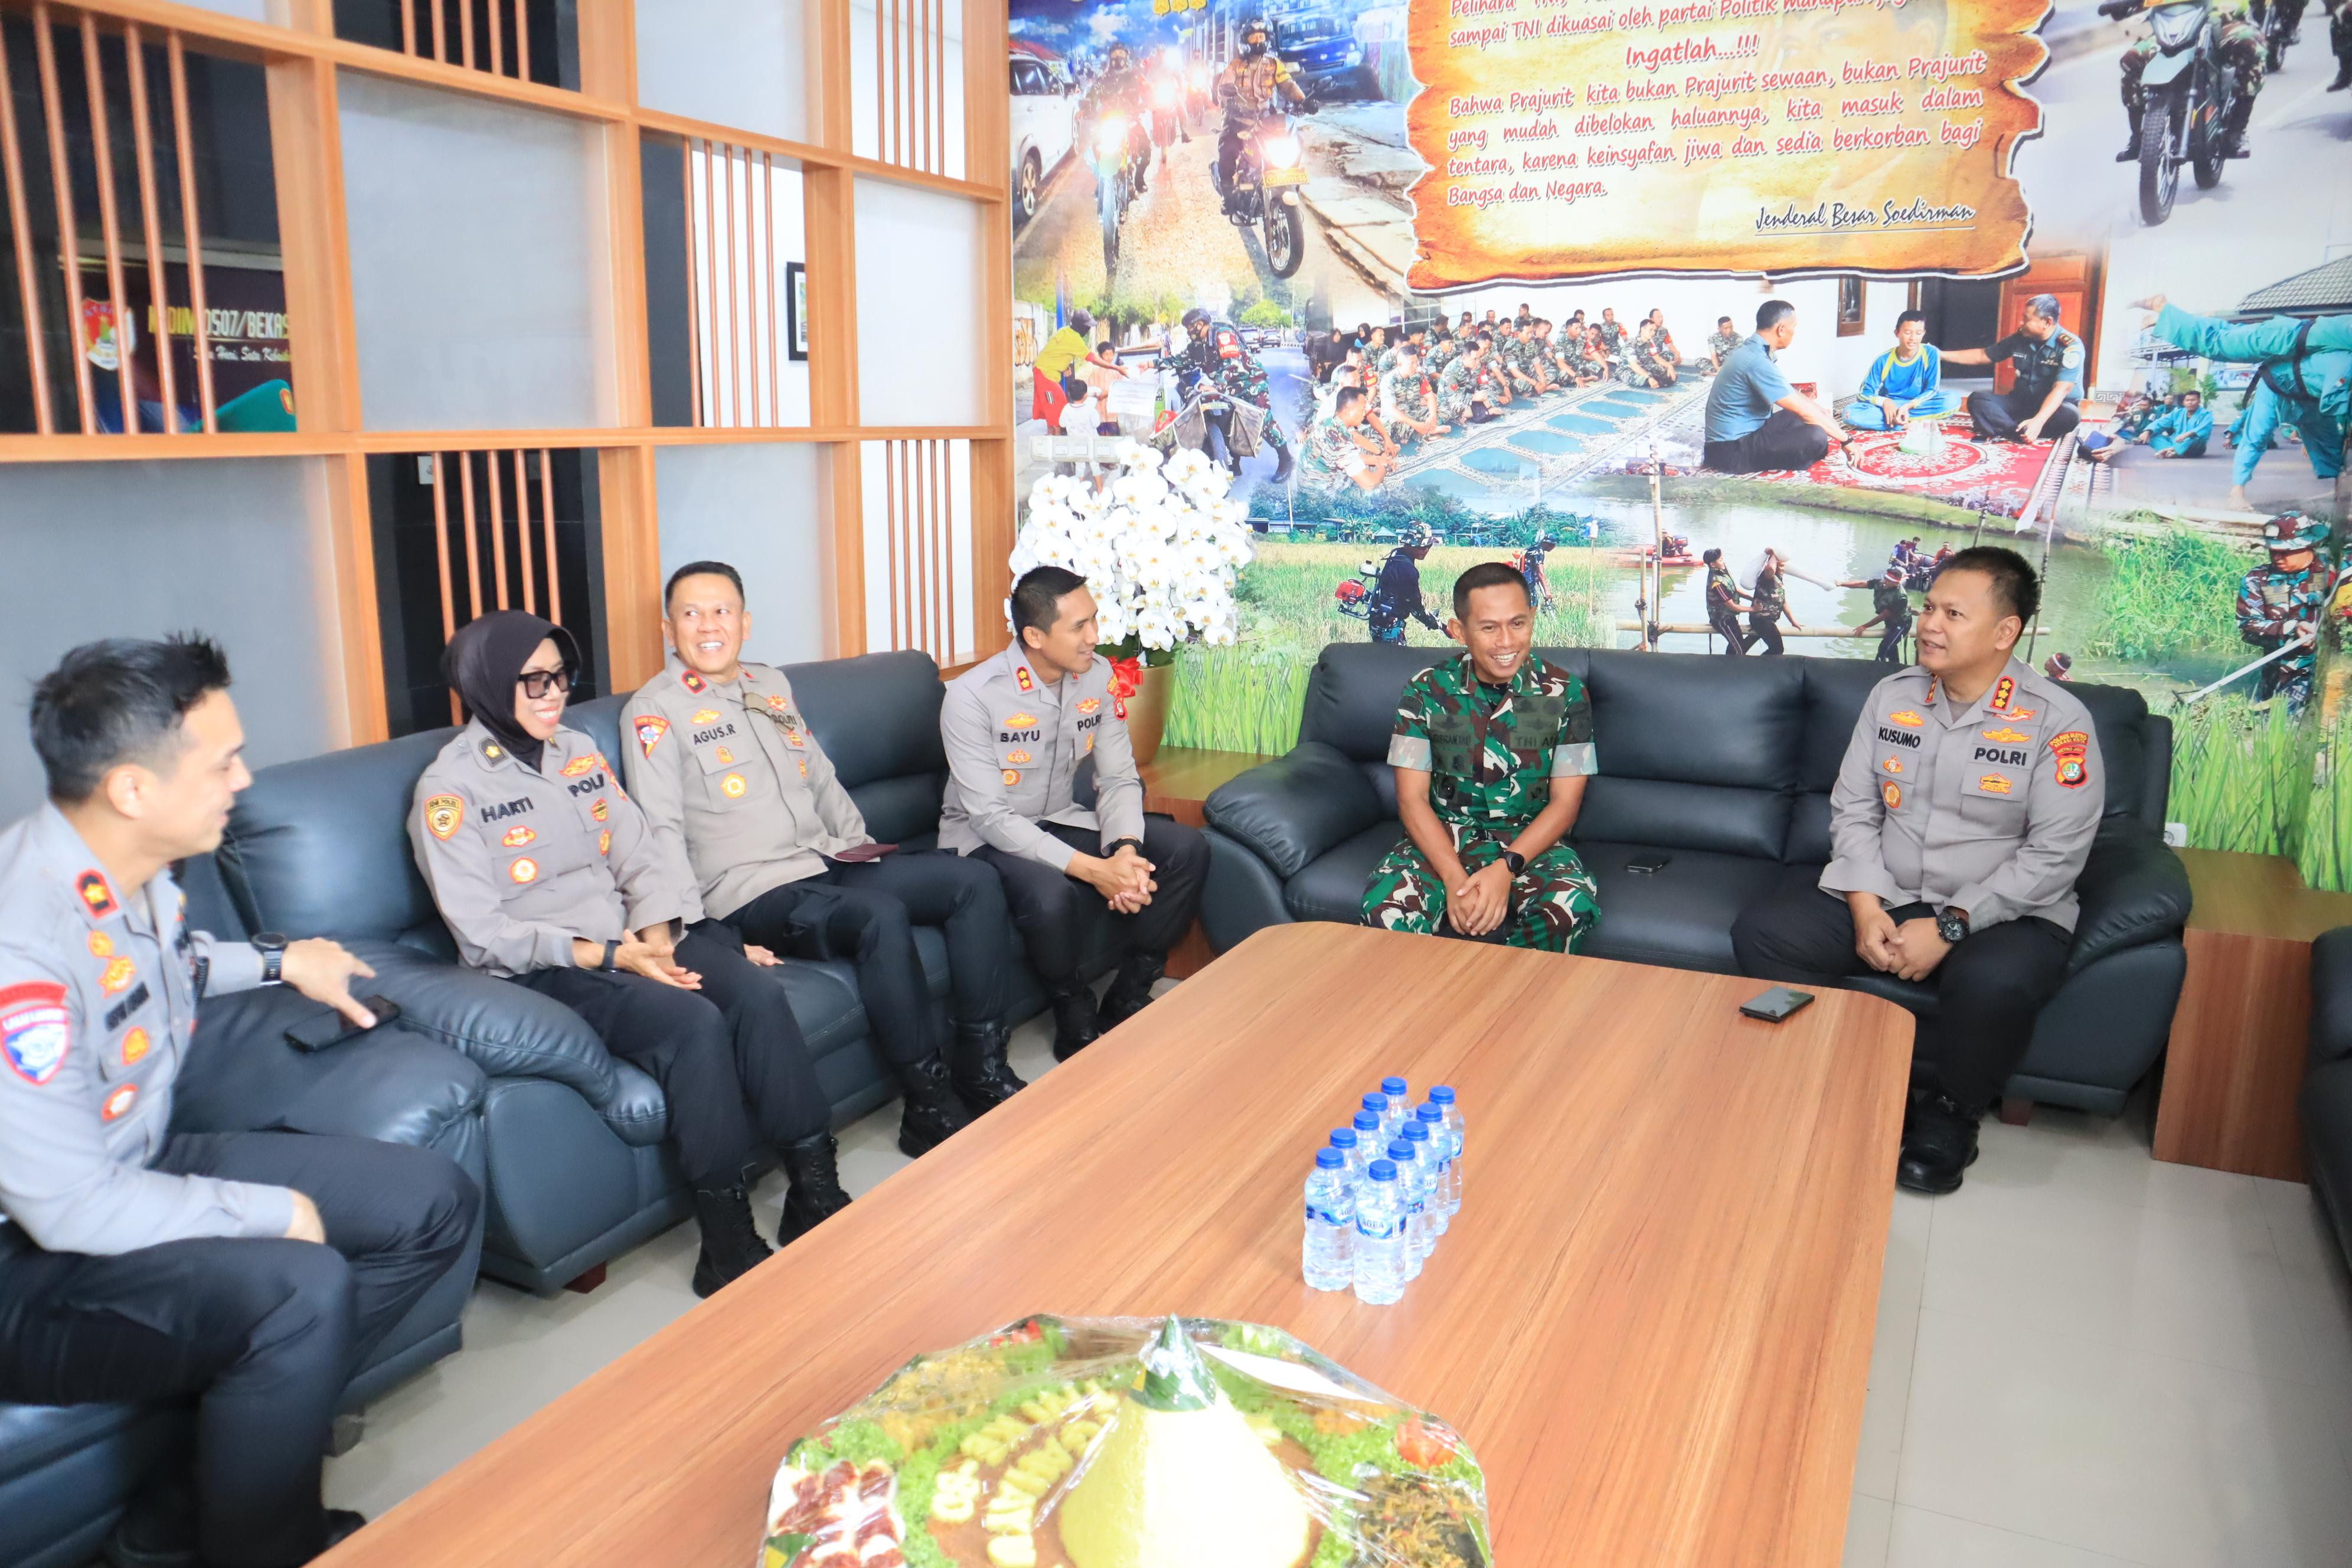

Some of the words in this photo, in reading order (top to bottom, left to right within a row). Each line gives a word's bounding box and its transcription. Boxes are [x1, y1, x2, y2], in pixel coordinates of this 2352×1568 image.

[1451, 0, 1515, 15] Pelihara
[1451, 21, 1506, 48] sampai
[1512, 19, 1541, 38] TNI
[1547, 9, 1613, 34] dikuasai
[1619, 6, 1652, 27] oleh
[1658, 0, 1713, 30] partai
[1720, 0, 1775, 17] Politik
[1451, 95, 1502, 115] Bahwa
[1510, 87, 1573, 114] Prajurit
[1587, 84, 1618, 103] kita
[1626, 80, 1677, 99] bukan
[1685, 71, 1756, 98] Prajurit
[1761, 70, 1834, 89] sewaan,
[1843, 60, 1899, 81] bukan
[1908, 51, 1986, 80] Prajurit
[1449, 130, 1487, 150] yang
[1504, 118, 1558, 139] mudah
[1575, 112, 1653, 135] dibelokan
[1671, 106, 1768, 128] haluannya,
[1787, 99, 1822, 118] kita
[1842, 90, 1902, 114] masuk
[1922, 87, 1981, 109] dalam
[1448, 157, 1513, 175] tentara,
[1523, 151, 1576, 169] karena
[1587, 141, 1675, 168] keinsyafan
[1684, 139, 1721, 164] jiwa
[1732, 135, 1765, 154] dan
[1776, 131, 1821, 152] sedia
[1834, 123, 1929, 148] berkorban
[1941, 120, 1981, 147] bagi
[1449, 187, 1503, 208] Bangsa
[1509, 181, 1539, 200] dan
[1546, 180, 1607, 202] Negara.
[1756, 202, 1827, 230] Jenderal
[1832, 202, 1878, 228] Besar
[1883, 197, 1975, 226] Soedirman
[204, 308, 289, 339] 0507/BEKAS
[694, 724, 736, 745] AGUS.R
[1000, 730, 1040, 743] BAYU
[1515, 736, 1537, 747] TNI
[1878, 726, 1921, 749] KUSUMO
[1974, 747, 2027, 766] POLRI
[481, 796, 534, 823] HARTI
[1361, 1219, 1385, 1230] AQUA
